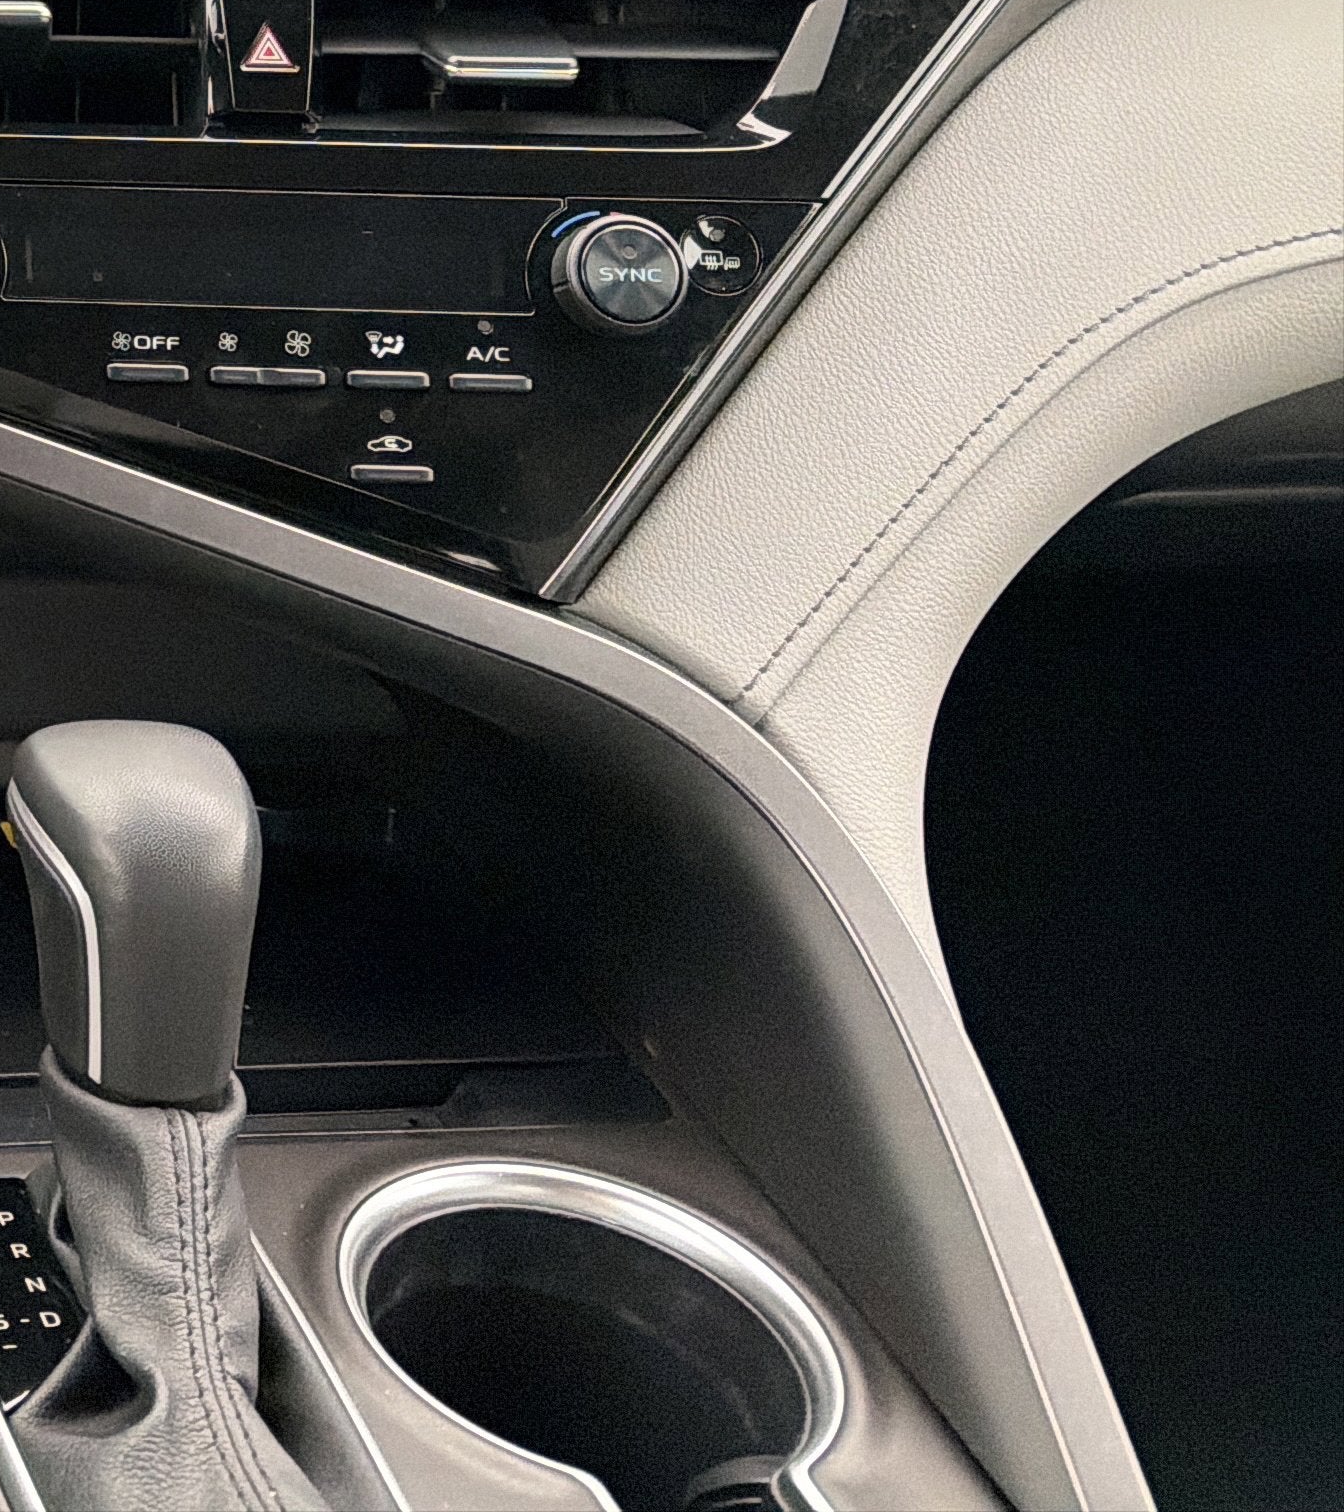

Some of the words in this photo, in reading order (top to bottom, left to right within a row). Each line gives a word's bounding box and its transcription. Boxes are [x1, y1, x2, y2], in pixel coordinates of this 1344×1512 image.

[598, 267, 663, 283] SYNC
[134, 336, 179, 350] OFF
[467, 347, 509, 362] A/C
[10, 1244, 30, 1258] R
[25, 1277, 46, 1292] N
[39, 1312, 61, 1327] D
